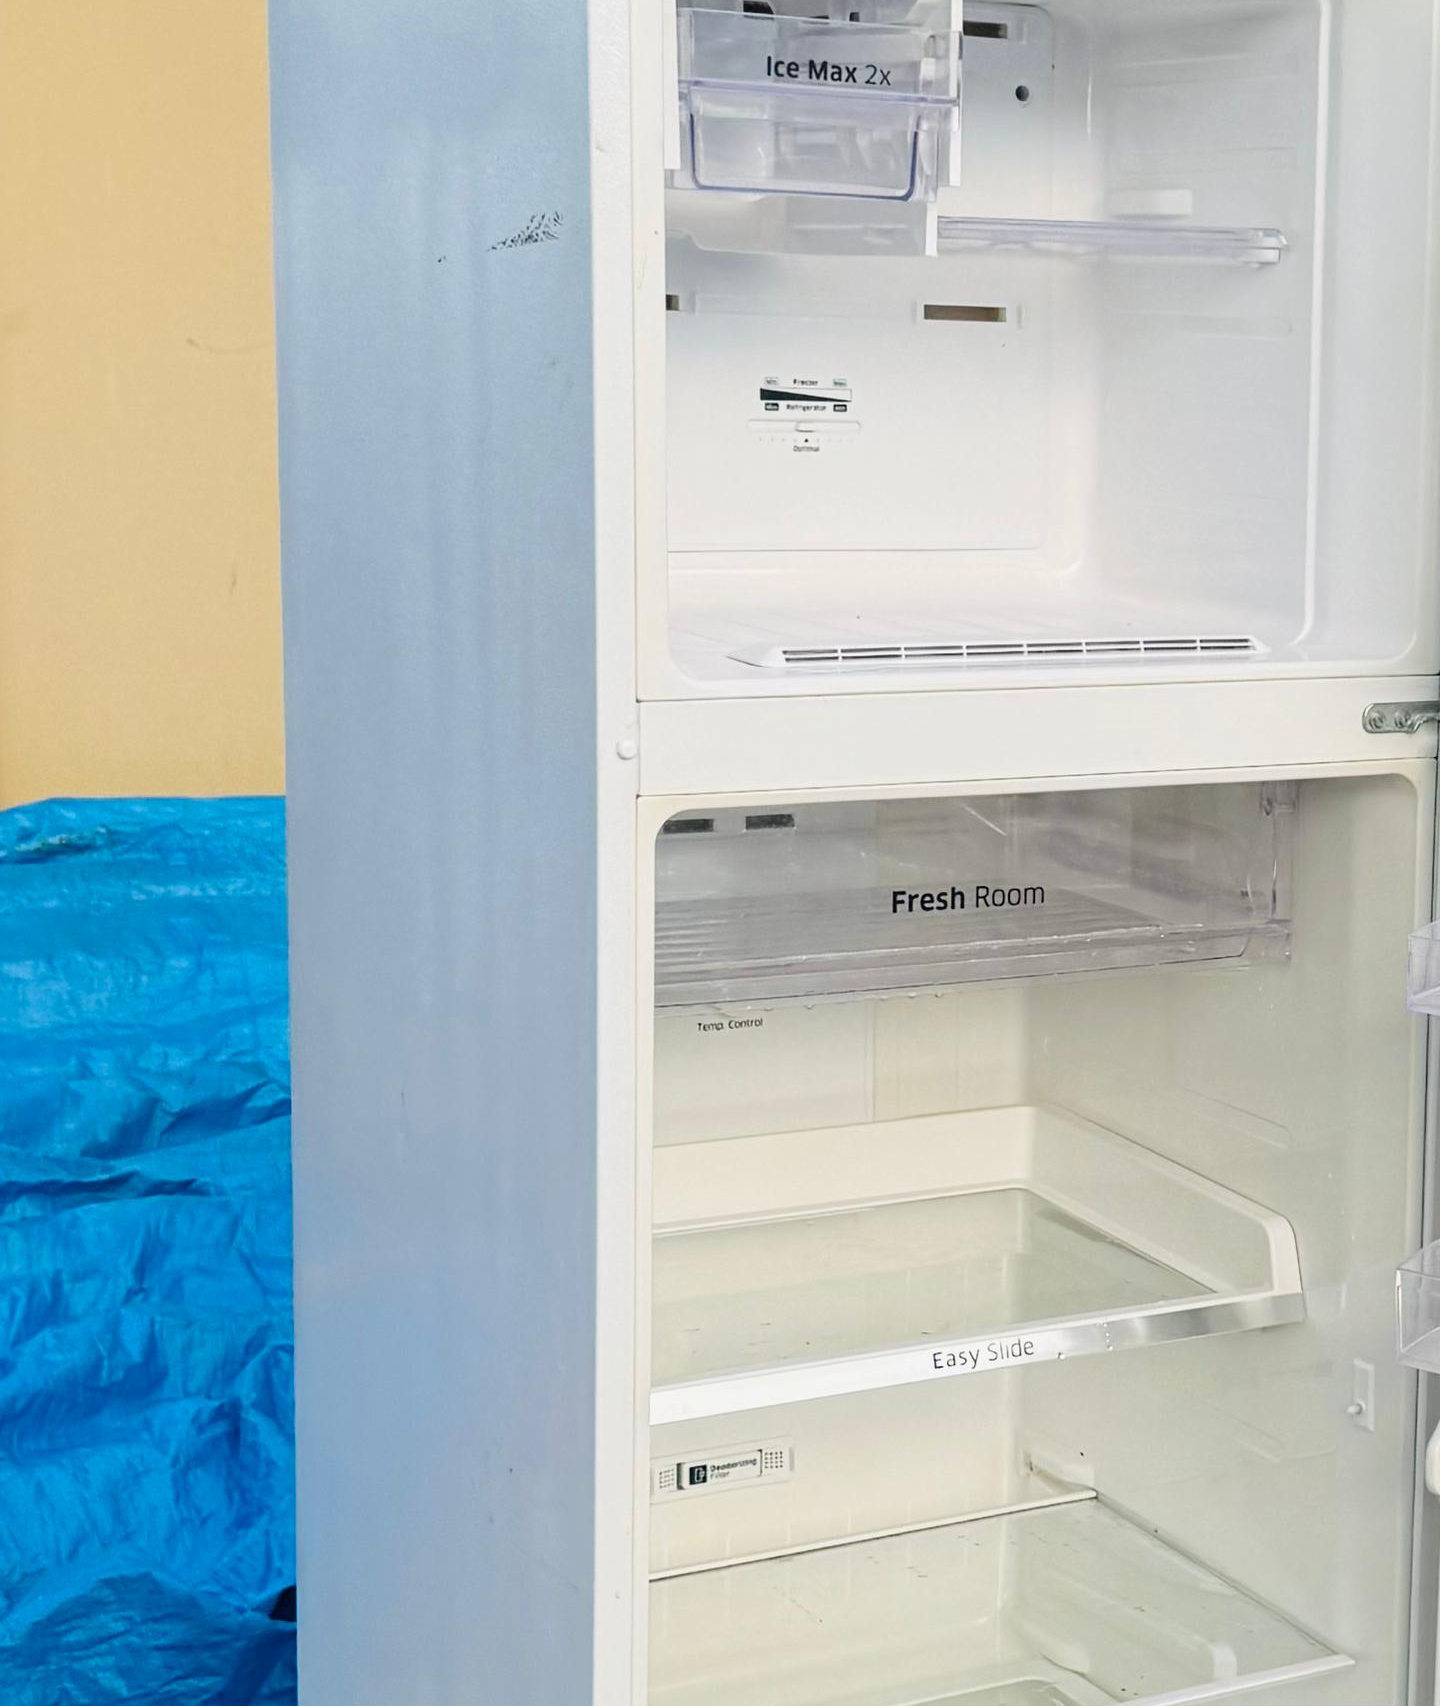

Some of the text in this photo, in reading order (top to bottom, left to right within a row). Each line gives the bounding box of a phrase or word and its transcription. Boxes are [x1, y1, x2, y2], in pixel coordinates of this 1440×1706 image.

[766, 55, 891, 86] Ice Max 2x
[891, 882, 1046, 915] Fresh Room
[728, 1018, 763, 1030] Control
[932, 1338, 1035, 1370] Easy Slide
